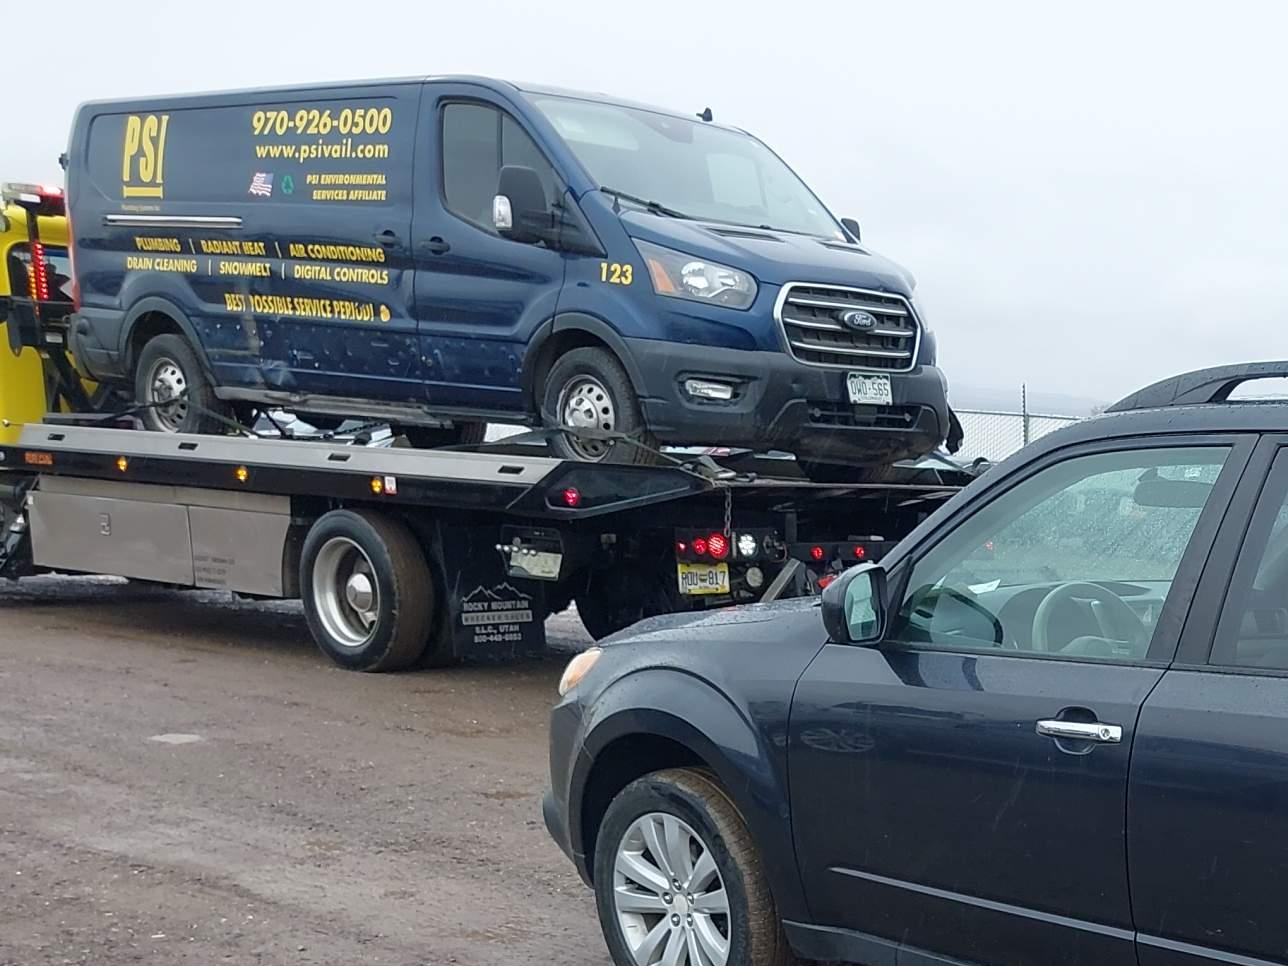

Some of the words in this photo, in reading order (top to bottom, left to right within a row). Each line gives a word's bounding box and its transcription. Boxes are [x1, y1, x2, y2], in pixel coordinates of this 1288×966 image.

[252, 107, 392, 135] 970-926-0500
[122, 114, 170, 184] PSI
[255, 138, 389, 163] www.psivail.com
[306, 174, 320, 185] PSI
[320, 173, 387, 185] ENVIRONMENTAL
[312, 189, 347, 201] SERVICES
[348, 189, 387, 201] AFFILIATE
[134, 236, 182, 253] PLUMBING
[200, 239, 241, 255] RADIANT
[241, 241, 267, 256] HEAT
[288, 243, 307, 258] AIR
[307, 244, 386, 263] CONDITIONING
[126, 256, 153, 271] DRAIN
[154, 258, 198, 273] CLEANING
[219, 261, 271, 277] SNOWMELT
[294, 265, 332, 281] DIGITAL
[334, 267, 389, 285] CONTROLS
[600, 262, 633, 285] 123
[223, 293, 247, 312] BEST
[293, 297, 333, 319] SERVICE
[853, 314, 873, 327] Ford
[463, 602, 489, 612] ROCKY
[491, 600, 529, 611] MOUNTAIN
[499, 624, 520, 633] UTAH
